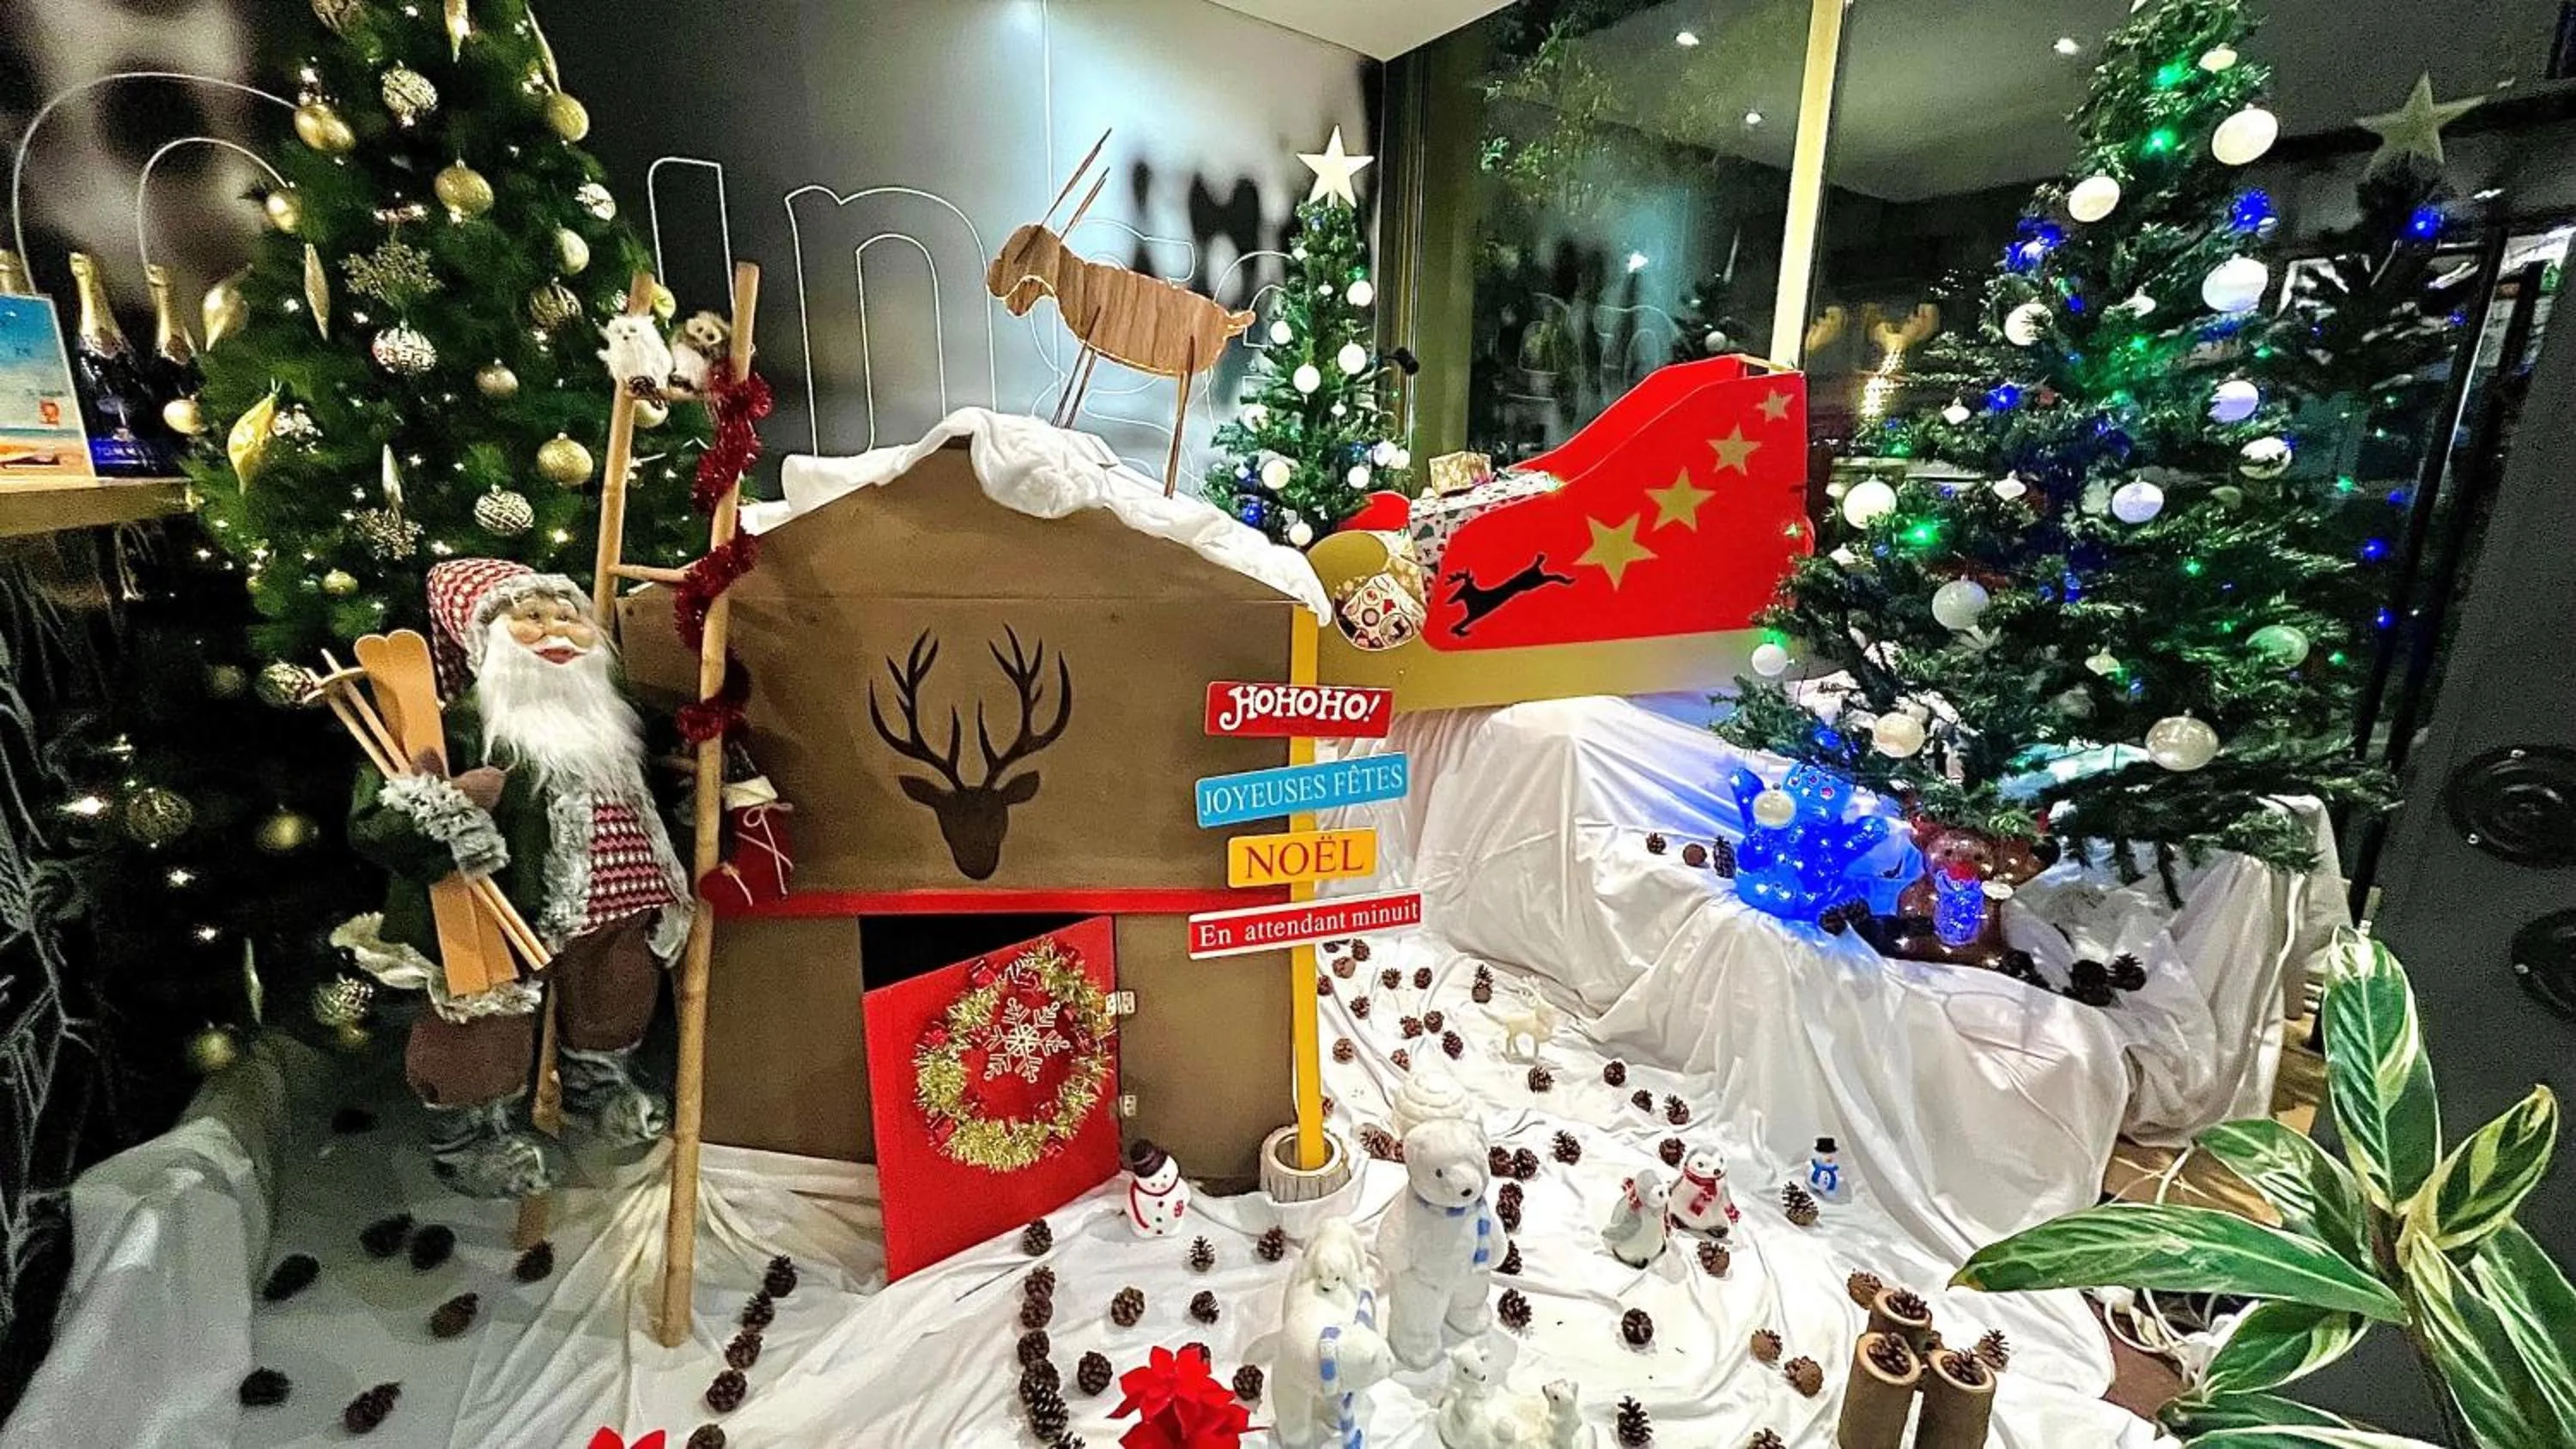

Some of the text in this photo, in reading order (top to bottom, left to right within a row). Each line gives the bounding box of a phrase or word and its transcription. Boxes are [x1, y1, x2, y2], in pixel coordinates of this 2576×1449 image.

[1219, 685, 1381, 731] HOHOHO!
[1202, 764, 1404, 816] JOYEUSES FÊTES
[1245, 835, 1364, 879] NOËL
[1199, 901, 1419, 948] En attendant minuit
